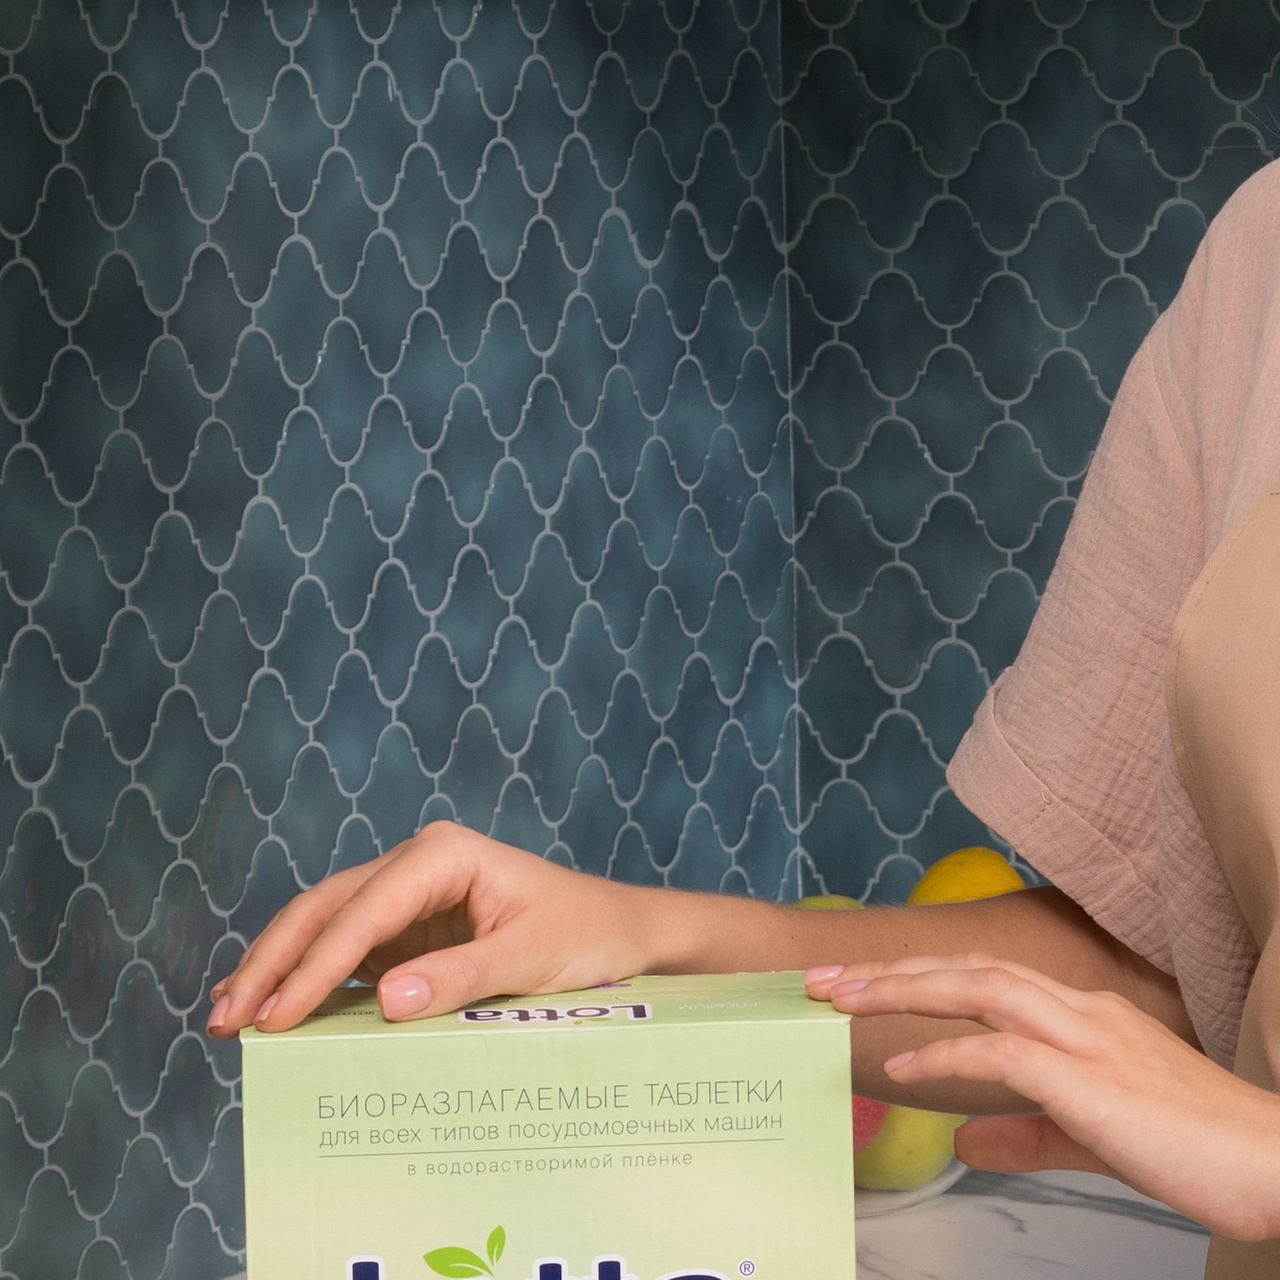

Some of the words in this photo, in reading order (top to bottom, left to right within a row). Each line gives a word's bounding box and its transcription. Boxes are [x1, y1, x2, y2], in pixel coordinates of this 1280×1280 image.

[464, 1003, 650, 1022] Lotta
[318, 1084, 630, 1119] БИОРАЗЛАГАЕМЫЕ
[644, 1079, 783, 1107] ТАБЛЕТКИ
[319, 1130, 360, 1149] для
[369, 1128, 422, 1145] всех
[430, 1125, 500, 1142] типов
[508, 1117, 696, 1143] посудомоечных
[704, 1114, 783, 1132] машин
[407, 1163, 417, 1176] в
[426, 1153, 613, 1177] водорастворимой
[622, 1152, 693, 1168] плёнке
